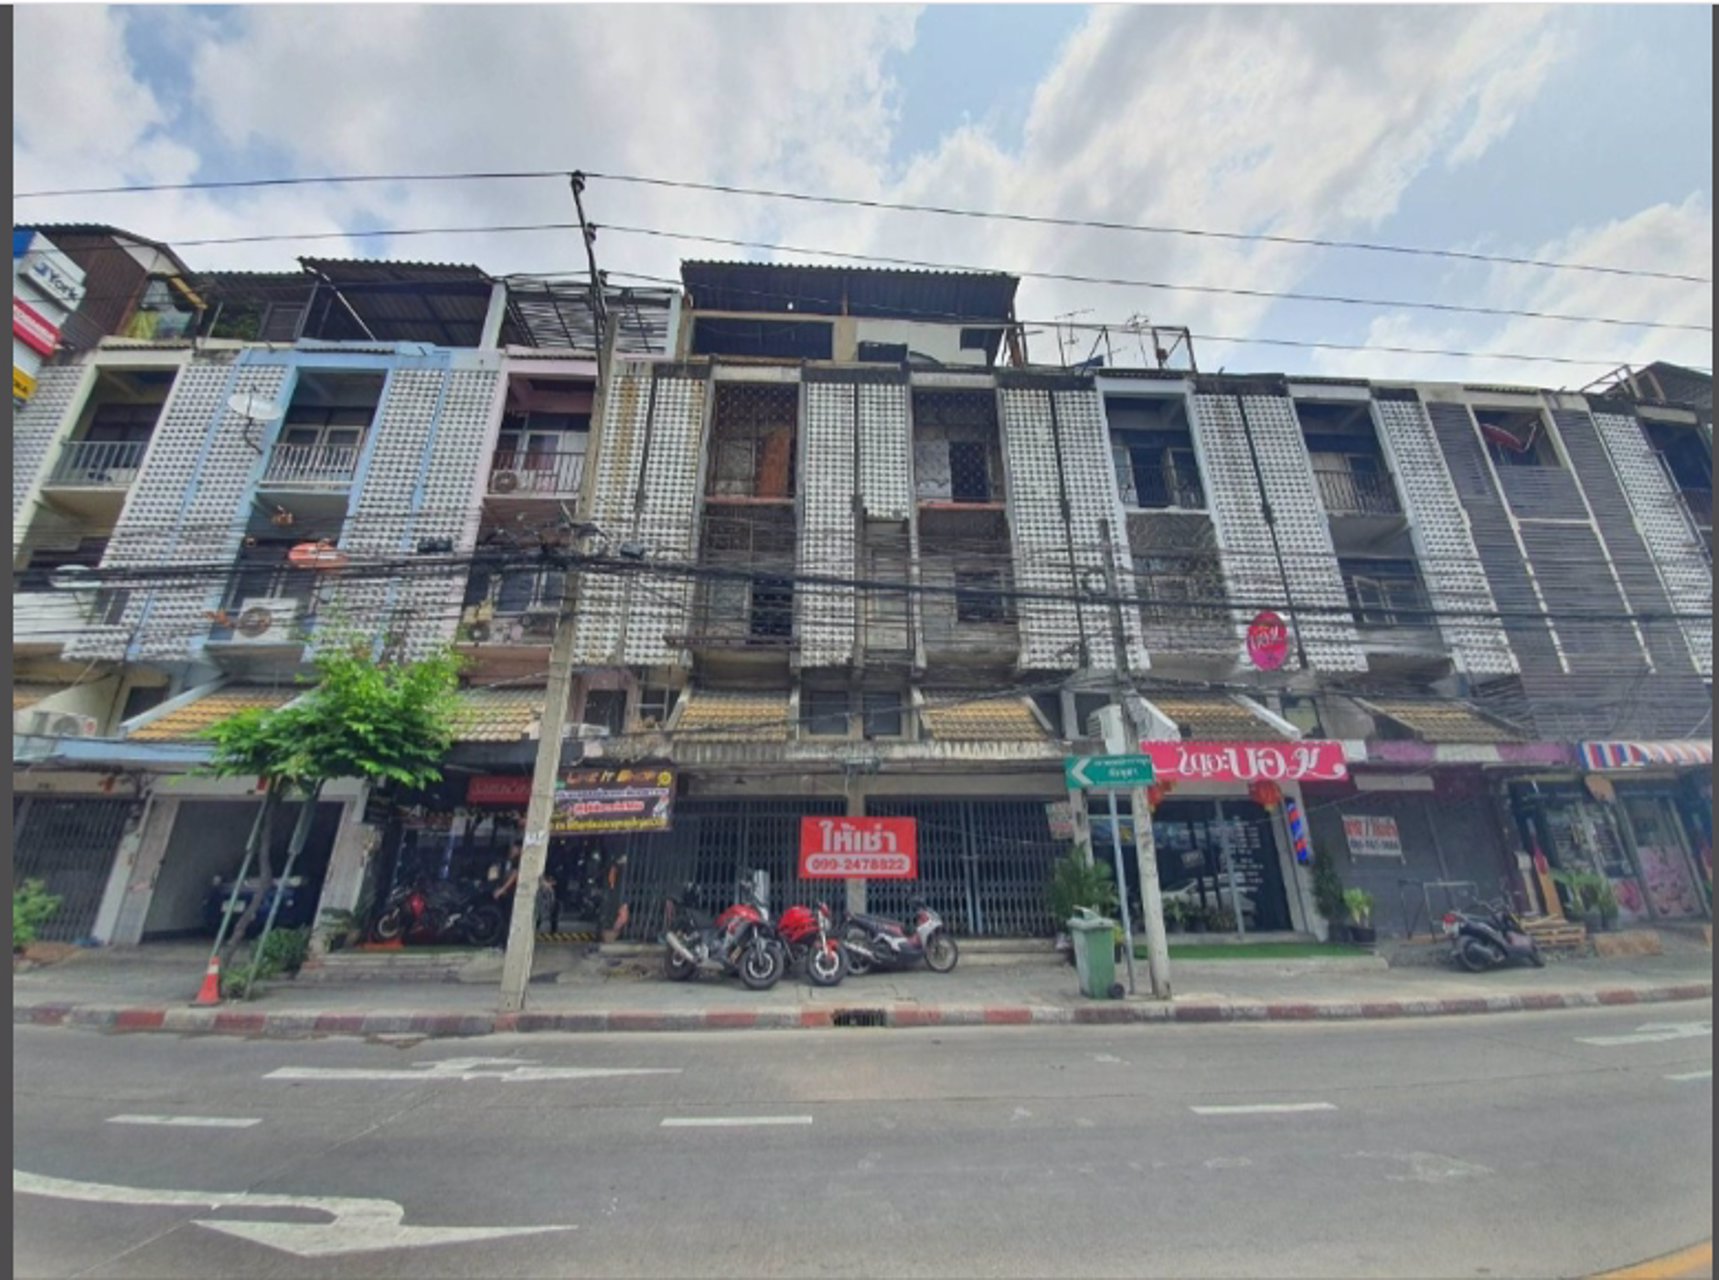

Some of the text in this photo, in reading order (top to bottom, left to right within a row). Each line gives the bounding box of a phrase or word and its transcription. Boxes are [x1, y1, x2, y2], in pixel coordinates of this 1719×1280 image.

[49, 269, 78, 302] York
[819, 820, 897, 852] ให้เช่า
[811, 858, 905, 871] 099-2478822
